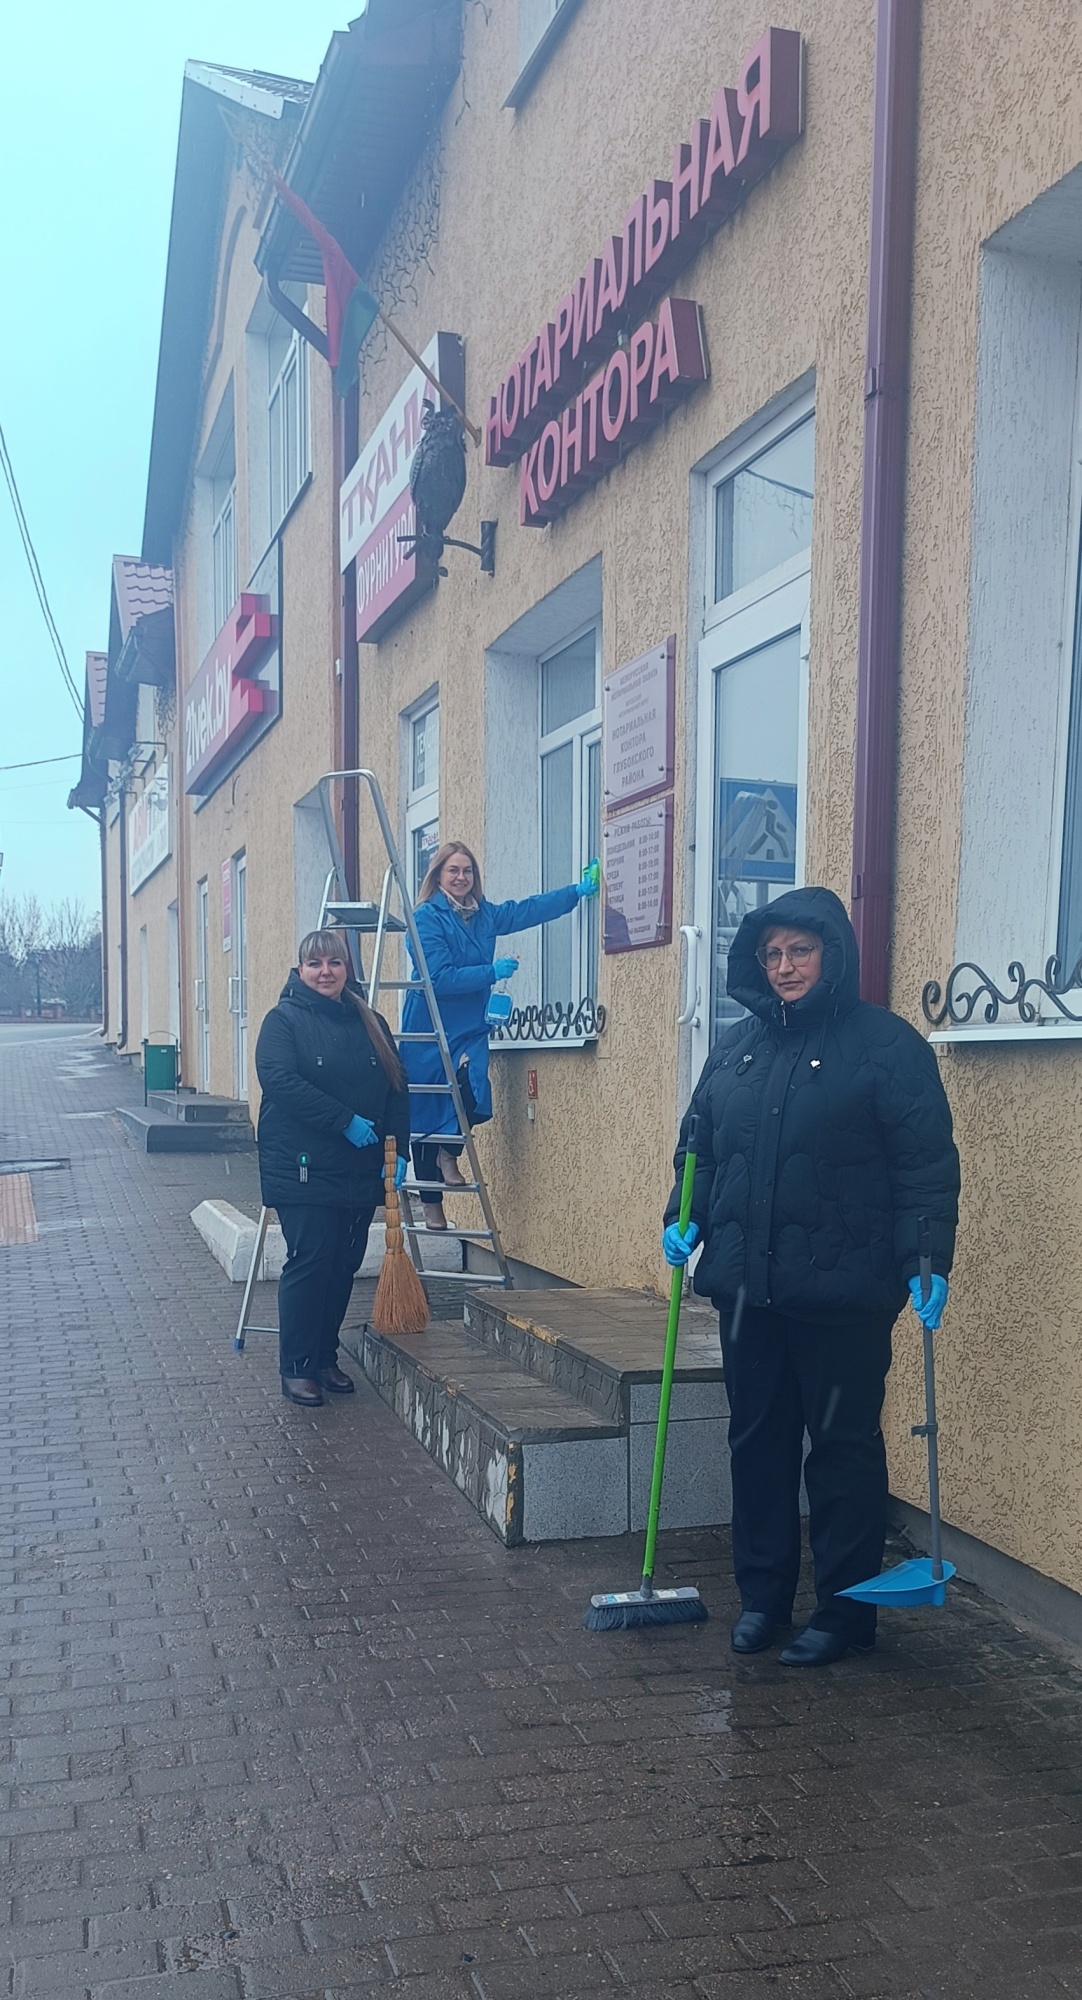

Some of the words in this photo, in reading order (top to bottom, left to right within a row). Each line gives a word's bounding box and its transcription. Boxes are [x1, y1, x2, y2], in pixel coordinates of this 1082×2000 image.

[486, 28, 778, 458] НОТАРИАЛЬНАЯ
[520, 298, 684, 518] КОНТОРА
[357, 504, 416, 614] ФУРНИТУРА
[185, 653, 232, 775] 21vek.by
[611, 708, 656, 741] НОТАРИАЛЬНАЯ
[620, 731, 647, 754] КОНТОРА
[613, 745, 655, 775] ГЛУБОКСКОГО
[621, 768, 645, 788] РАЙОНА
[606, 855, 625, 868] ВТОРНИК
[606, 869, 620, 881] СРЕДА
[607, 881, 624, 893] ЕТВЕРГ
